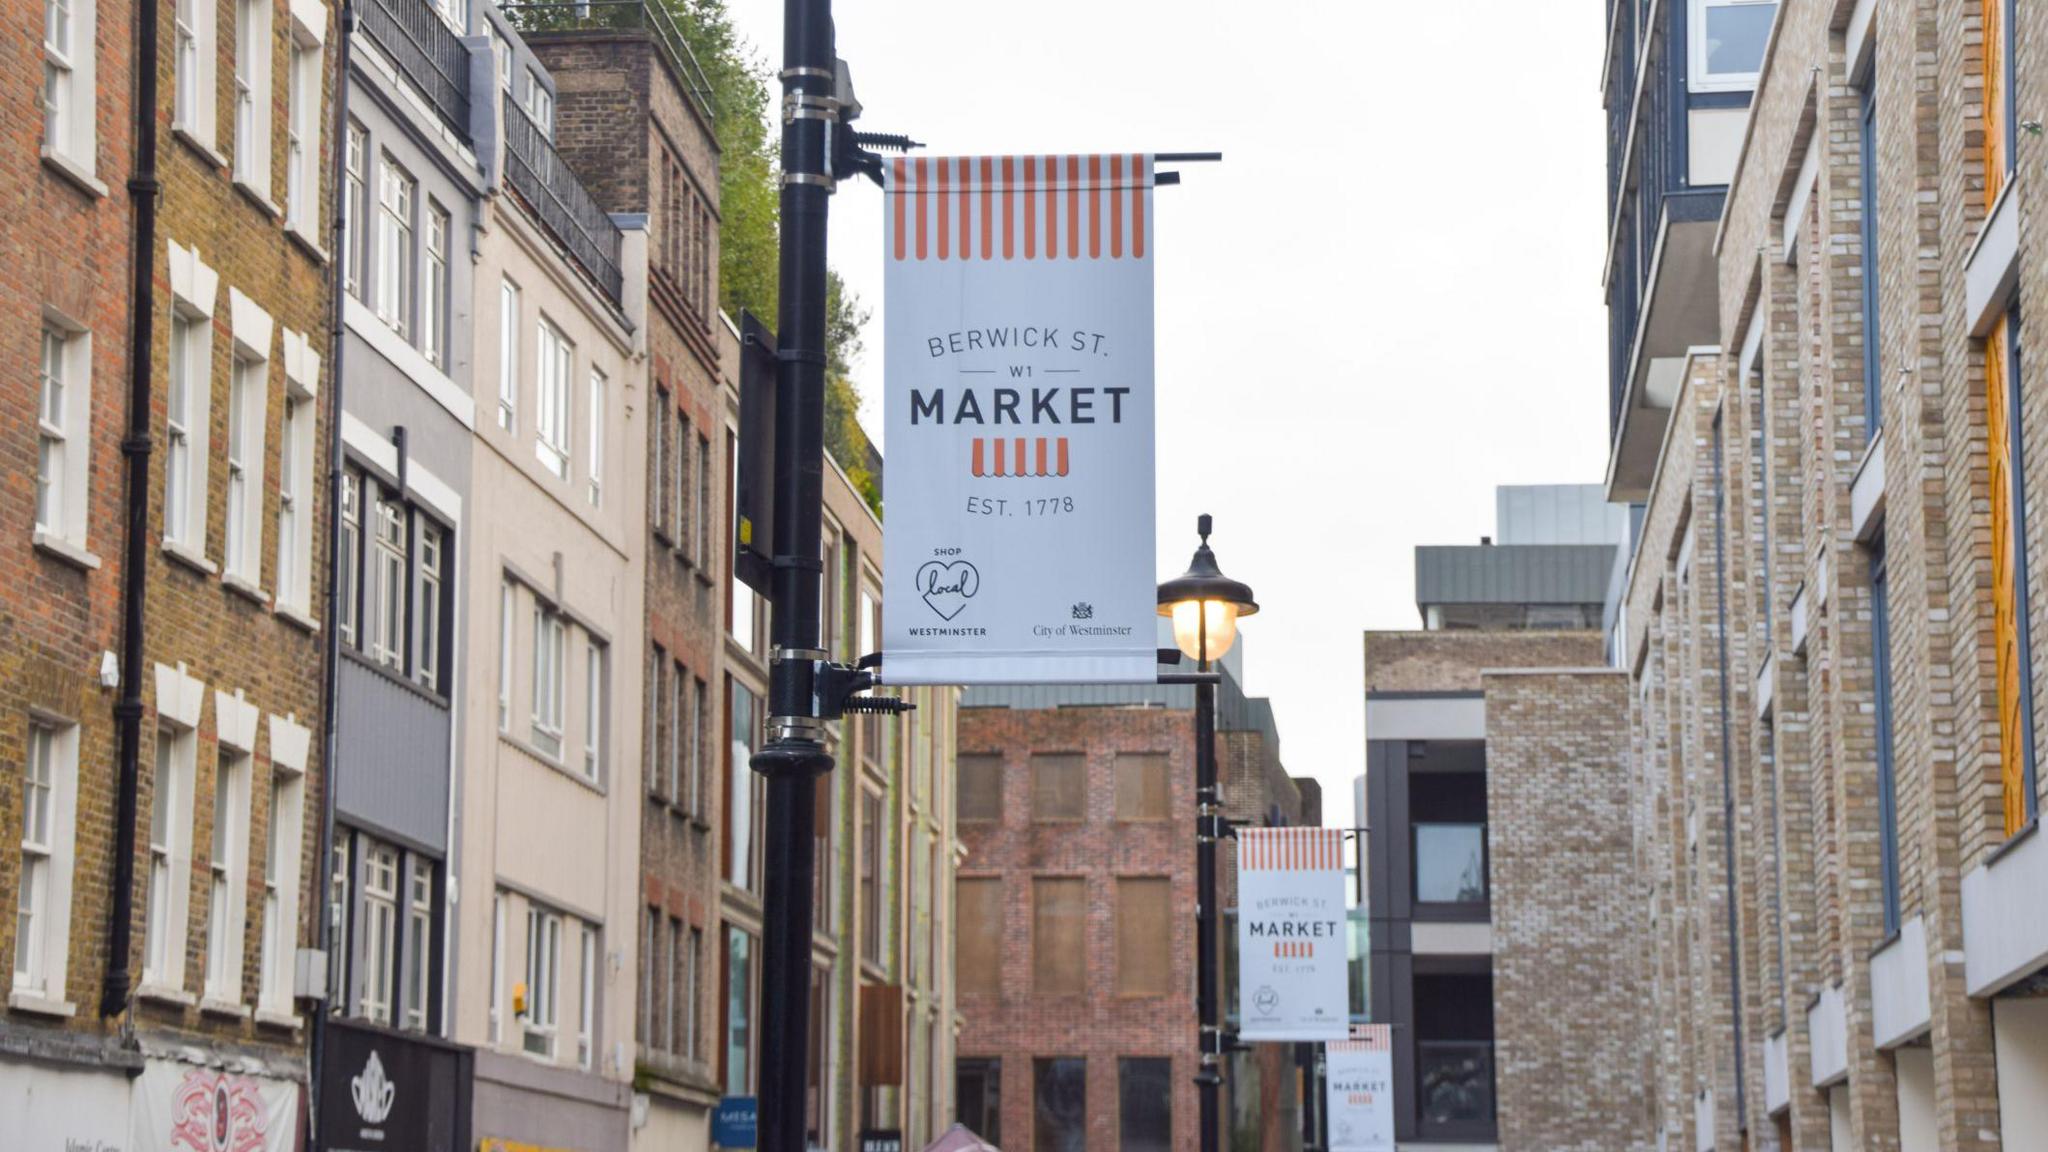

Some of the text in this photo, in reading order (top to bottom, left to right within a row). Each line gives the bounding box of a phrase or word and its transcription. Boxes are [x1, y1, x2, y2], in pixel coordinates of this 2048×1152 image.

[928, 327, 1108, 357] BERWICK ST.
[1009, 366, 1032, 377] W1
[910, 387, 1130, 425] MARKET
[966, 496, 1074, 517] EST. 1778
[933, 548, 962, 556] SHOP
[929, 569, 970, 597] local
[909, 627, 987, 636] WESTMINSTER
[1033, 624, 1132, 639] City of Westminster
[1249, 921, 1337, 937] MARKET
[1333, 1082, 1385, 1092] MARKET
